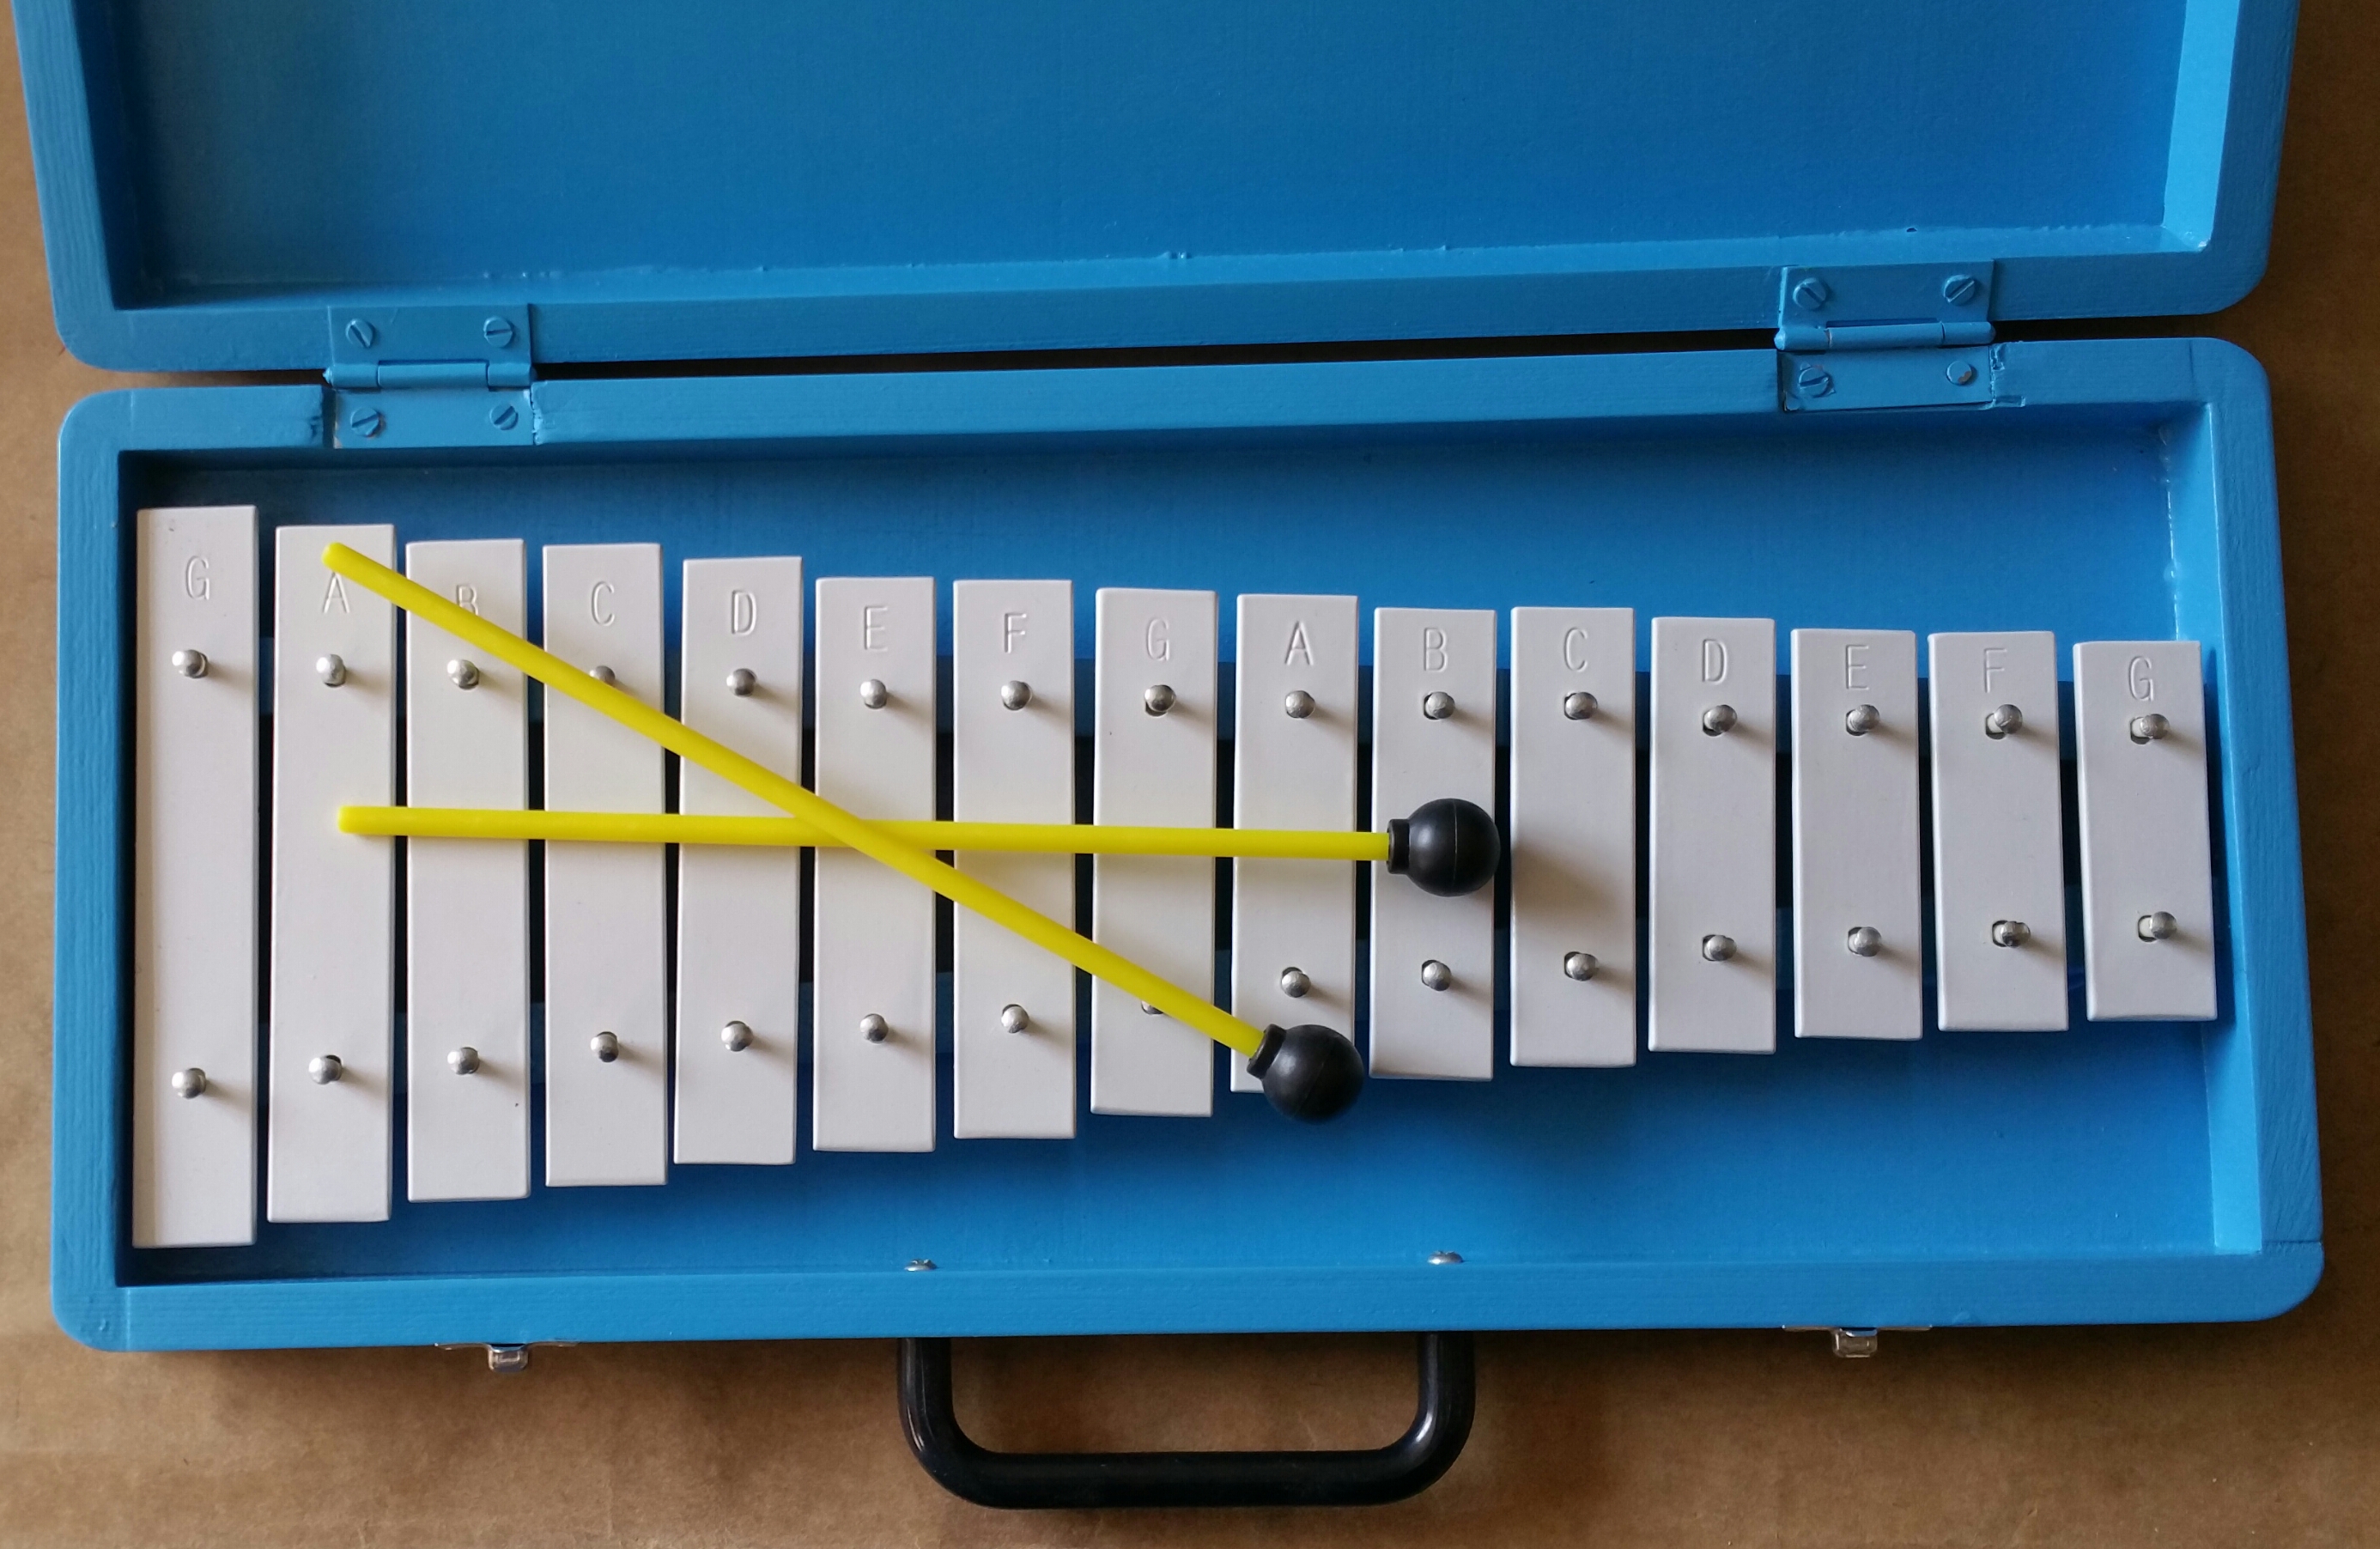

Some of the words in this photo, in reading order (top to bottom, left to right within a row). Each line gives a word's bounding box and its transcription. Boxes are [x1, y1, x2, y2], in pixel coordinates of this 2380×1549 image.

[185, 555, 209, 600] G
[322, 571, 350, 614] A
[591, 580, 616, 627] C
[731, 588, 757, 636] D
[863, 604, 889, 652] E
[1004, 611, 1028, 654] F
[1145, 616, 1170, 661] G
[1283, 620, 1314, 666] A
[1424, 626, 1448, 673] B
[1563, 626, 1589, 673] C
[1701, 637, 1729, 685] D
[1845, 643, 1870, 691] E
[1983, 647, 2008, 693] F
[2128, 655, 2156, 702] G
